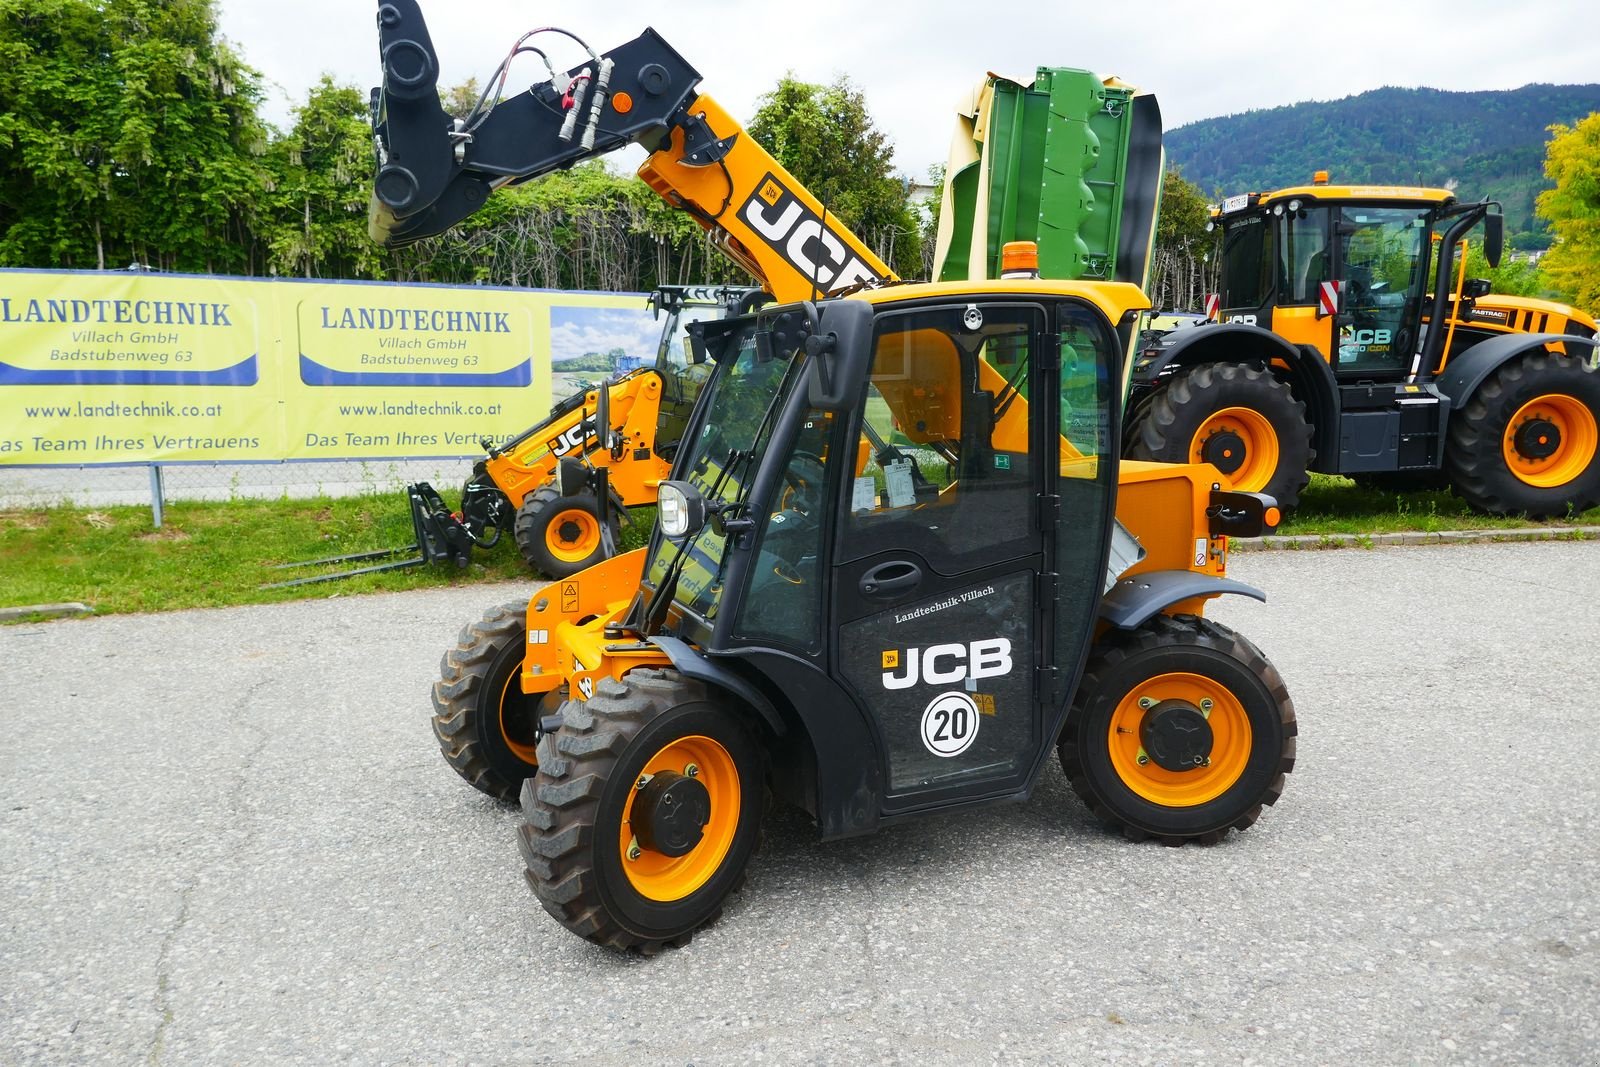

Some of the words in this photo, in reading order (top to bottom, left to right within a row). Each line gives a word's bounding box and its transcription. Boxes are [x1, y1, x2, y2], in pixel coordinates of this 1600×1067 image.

[0, 298, 232, 326] LANDTECHNIK
[321, 307, 511, 333] LANDTECHNIK
[72, 331, 123, 343] Villach
[130, 332, 179, 344] GmbH
[378, 337, 422, 349] Villach
[426, 338, 467, 350] GmbH
[50, 349, 168, 364] Badstubenweg
[175, 351, 193, 362] 63
[360, 353, 458, 368] Badstubenweg
[463, 355, 479, 366] 63
[25, 401, 222, 418] www.landtechnik.co.at
[339, 401, 502, 416] www.landtechnik.co.at
[0, 440, 23, 451] as
[32, 437, 87, 451] Team
[95, 435, 145, 450] Ihres
[152, 435, 259, 449] Vertrauens
[306, 433, 338, 447] Das
[345, 432, 390, 446] Team
[396, 431, 438, 445] Ihres
[444, 431, 517, 445] Vertraue
[894, 585, 995, 624] Landtechnik-Villach
[882, 637, 1013, 690] JCB
[933, 707, 968, 742] 20
